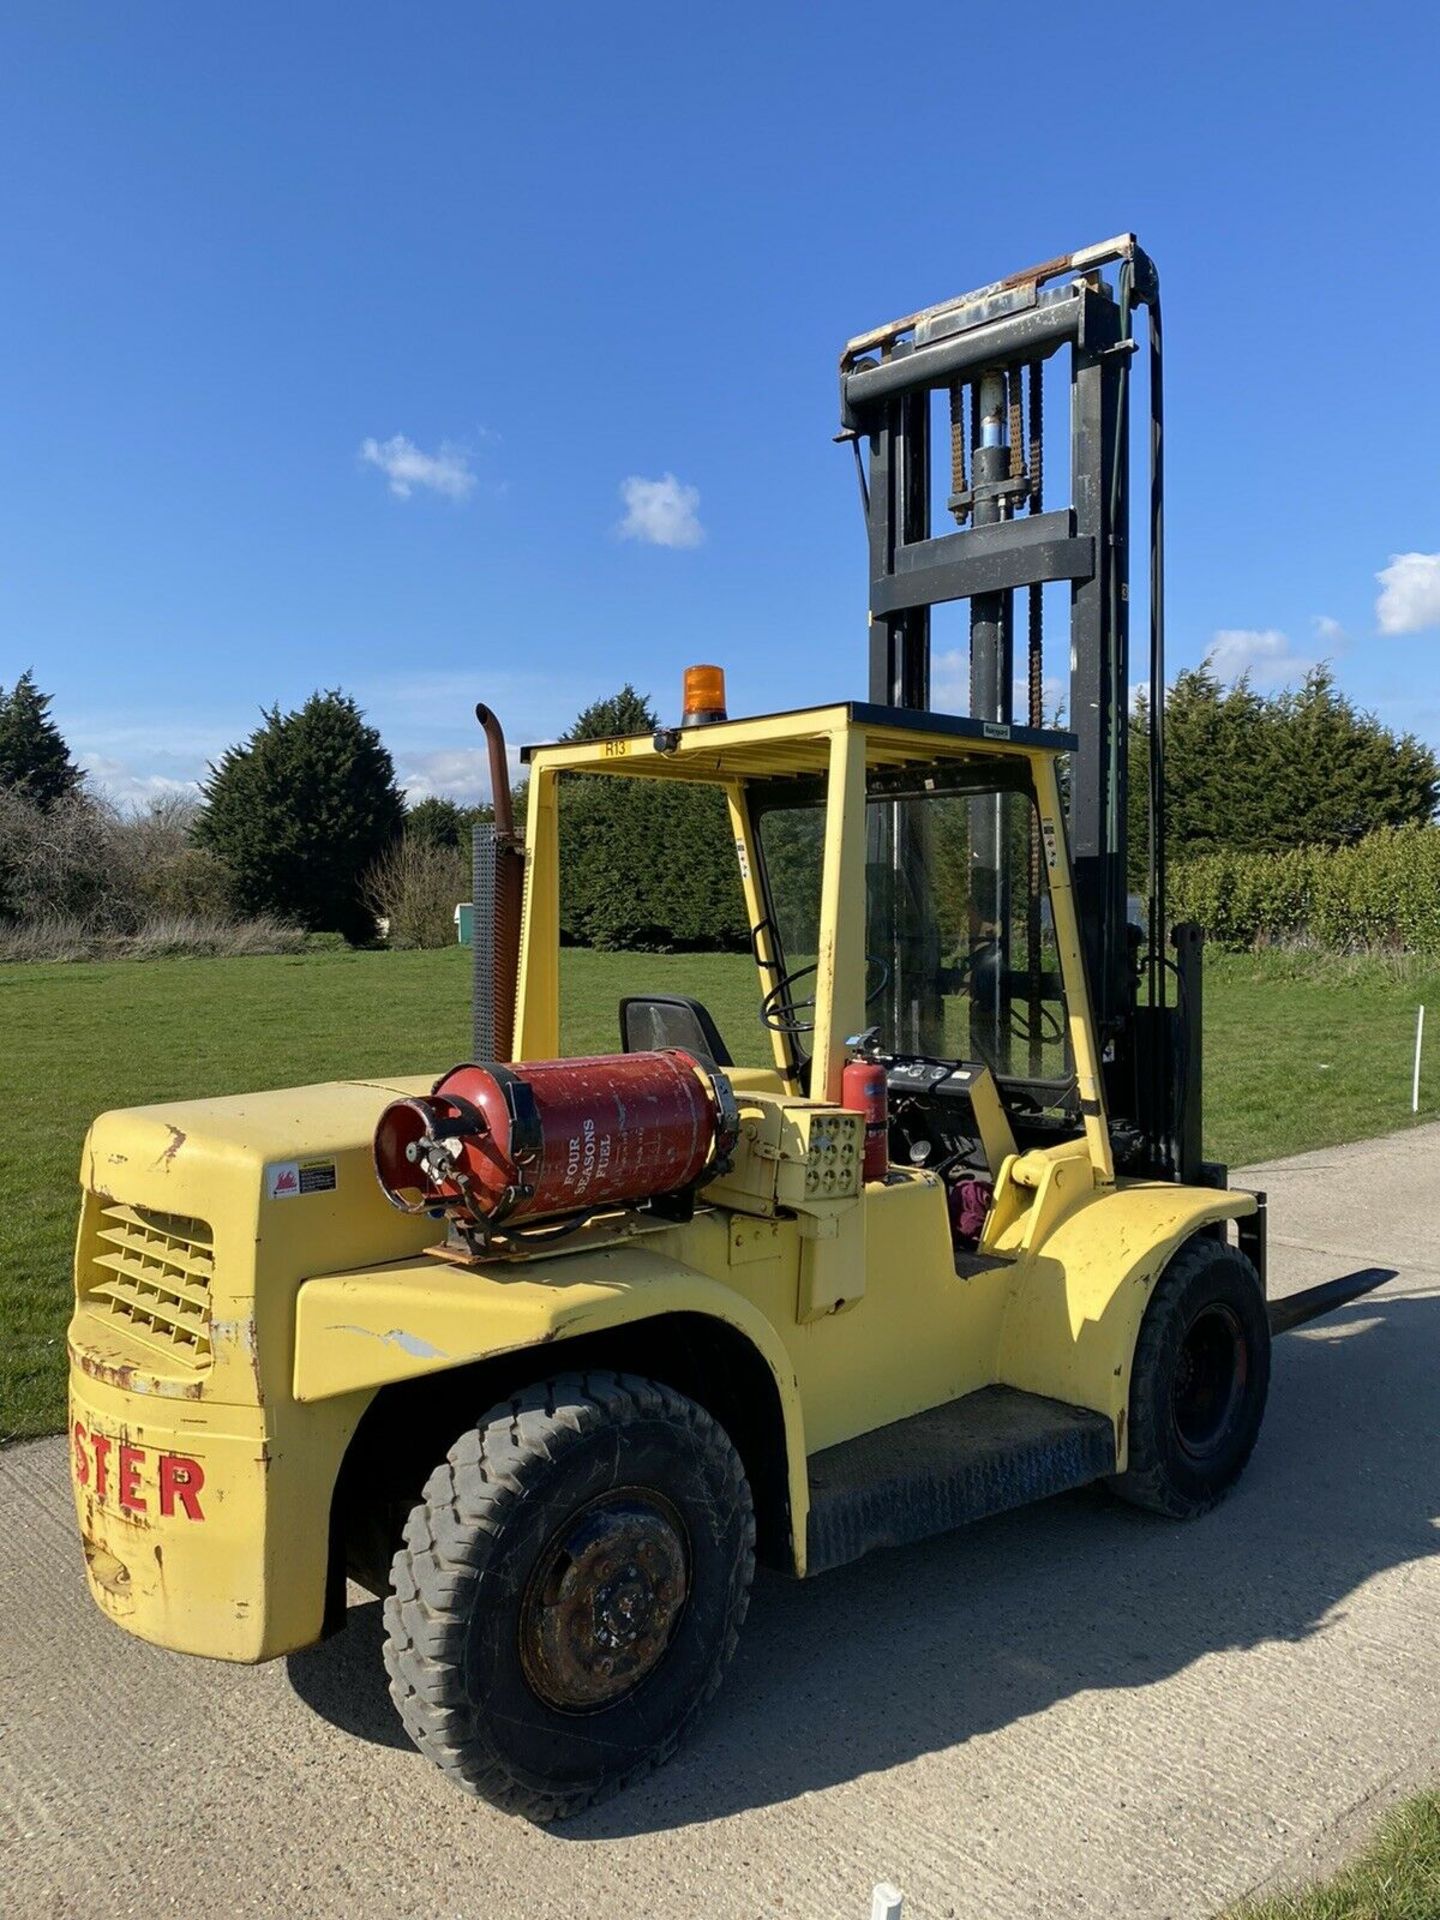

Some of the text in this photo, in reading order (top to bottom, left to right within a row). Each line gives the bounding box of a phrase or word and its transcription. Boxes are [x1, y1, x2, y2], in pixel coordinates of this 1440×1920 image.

[606, 740, 625, 756] R13
[564, 1137, 580, 1185] FOUR
[574, 1119, 595, 1195] SEASONS
[596, 1134, 611, 1178] FUEL
